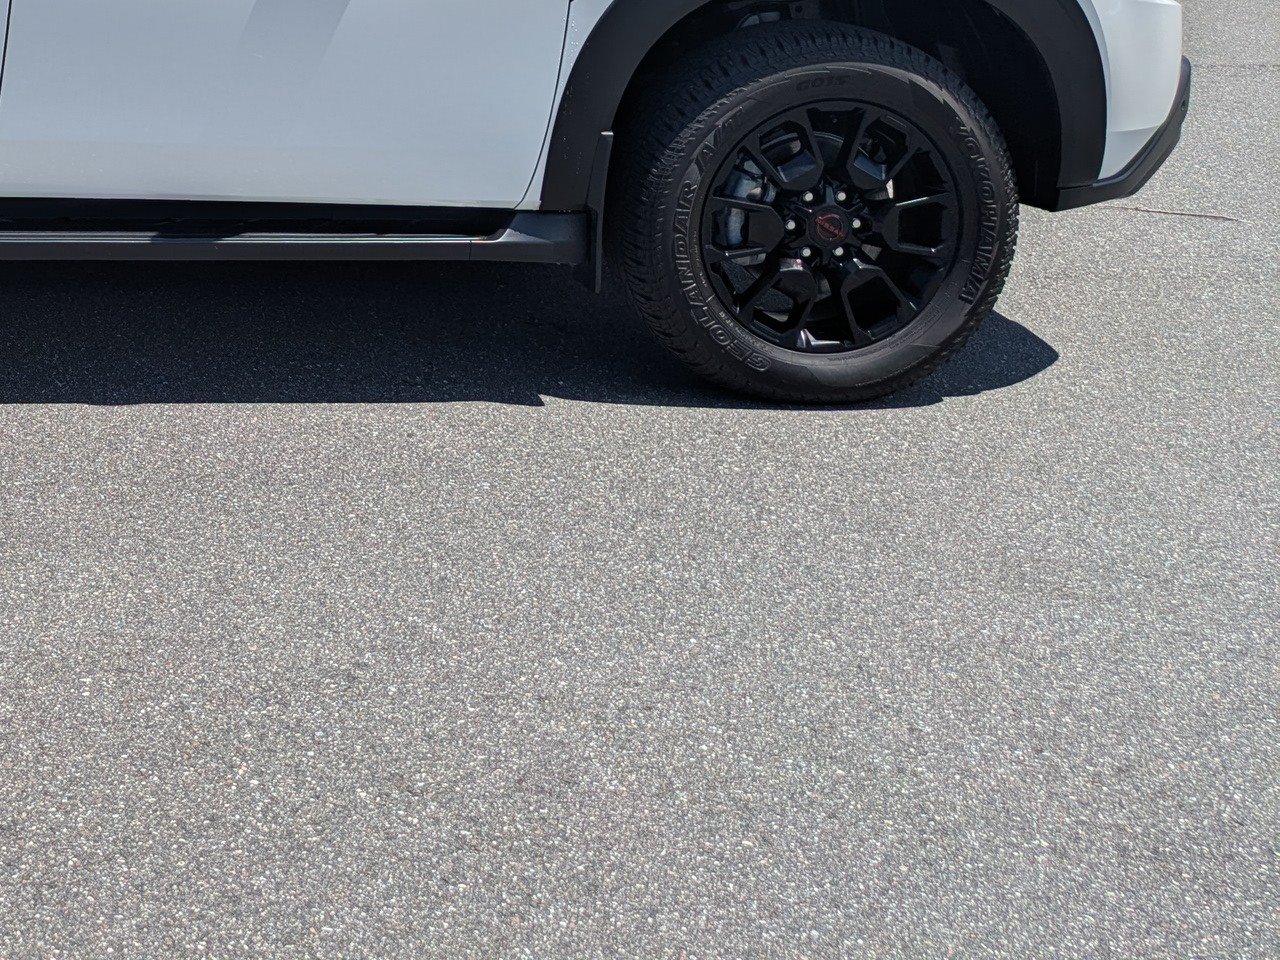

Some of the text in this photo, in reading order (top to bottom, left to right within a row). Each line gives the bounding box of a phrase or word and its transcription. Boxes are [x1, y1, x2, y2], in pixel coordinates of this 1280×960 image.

[672, 181, 771, 372] GEOLANDAR
[814, 218, 846, 238] NISSAN
[952, 116, 998, 303] YOKOHAMA
